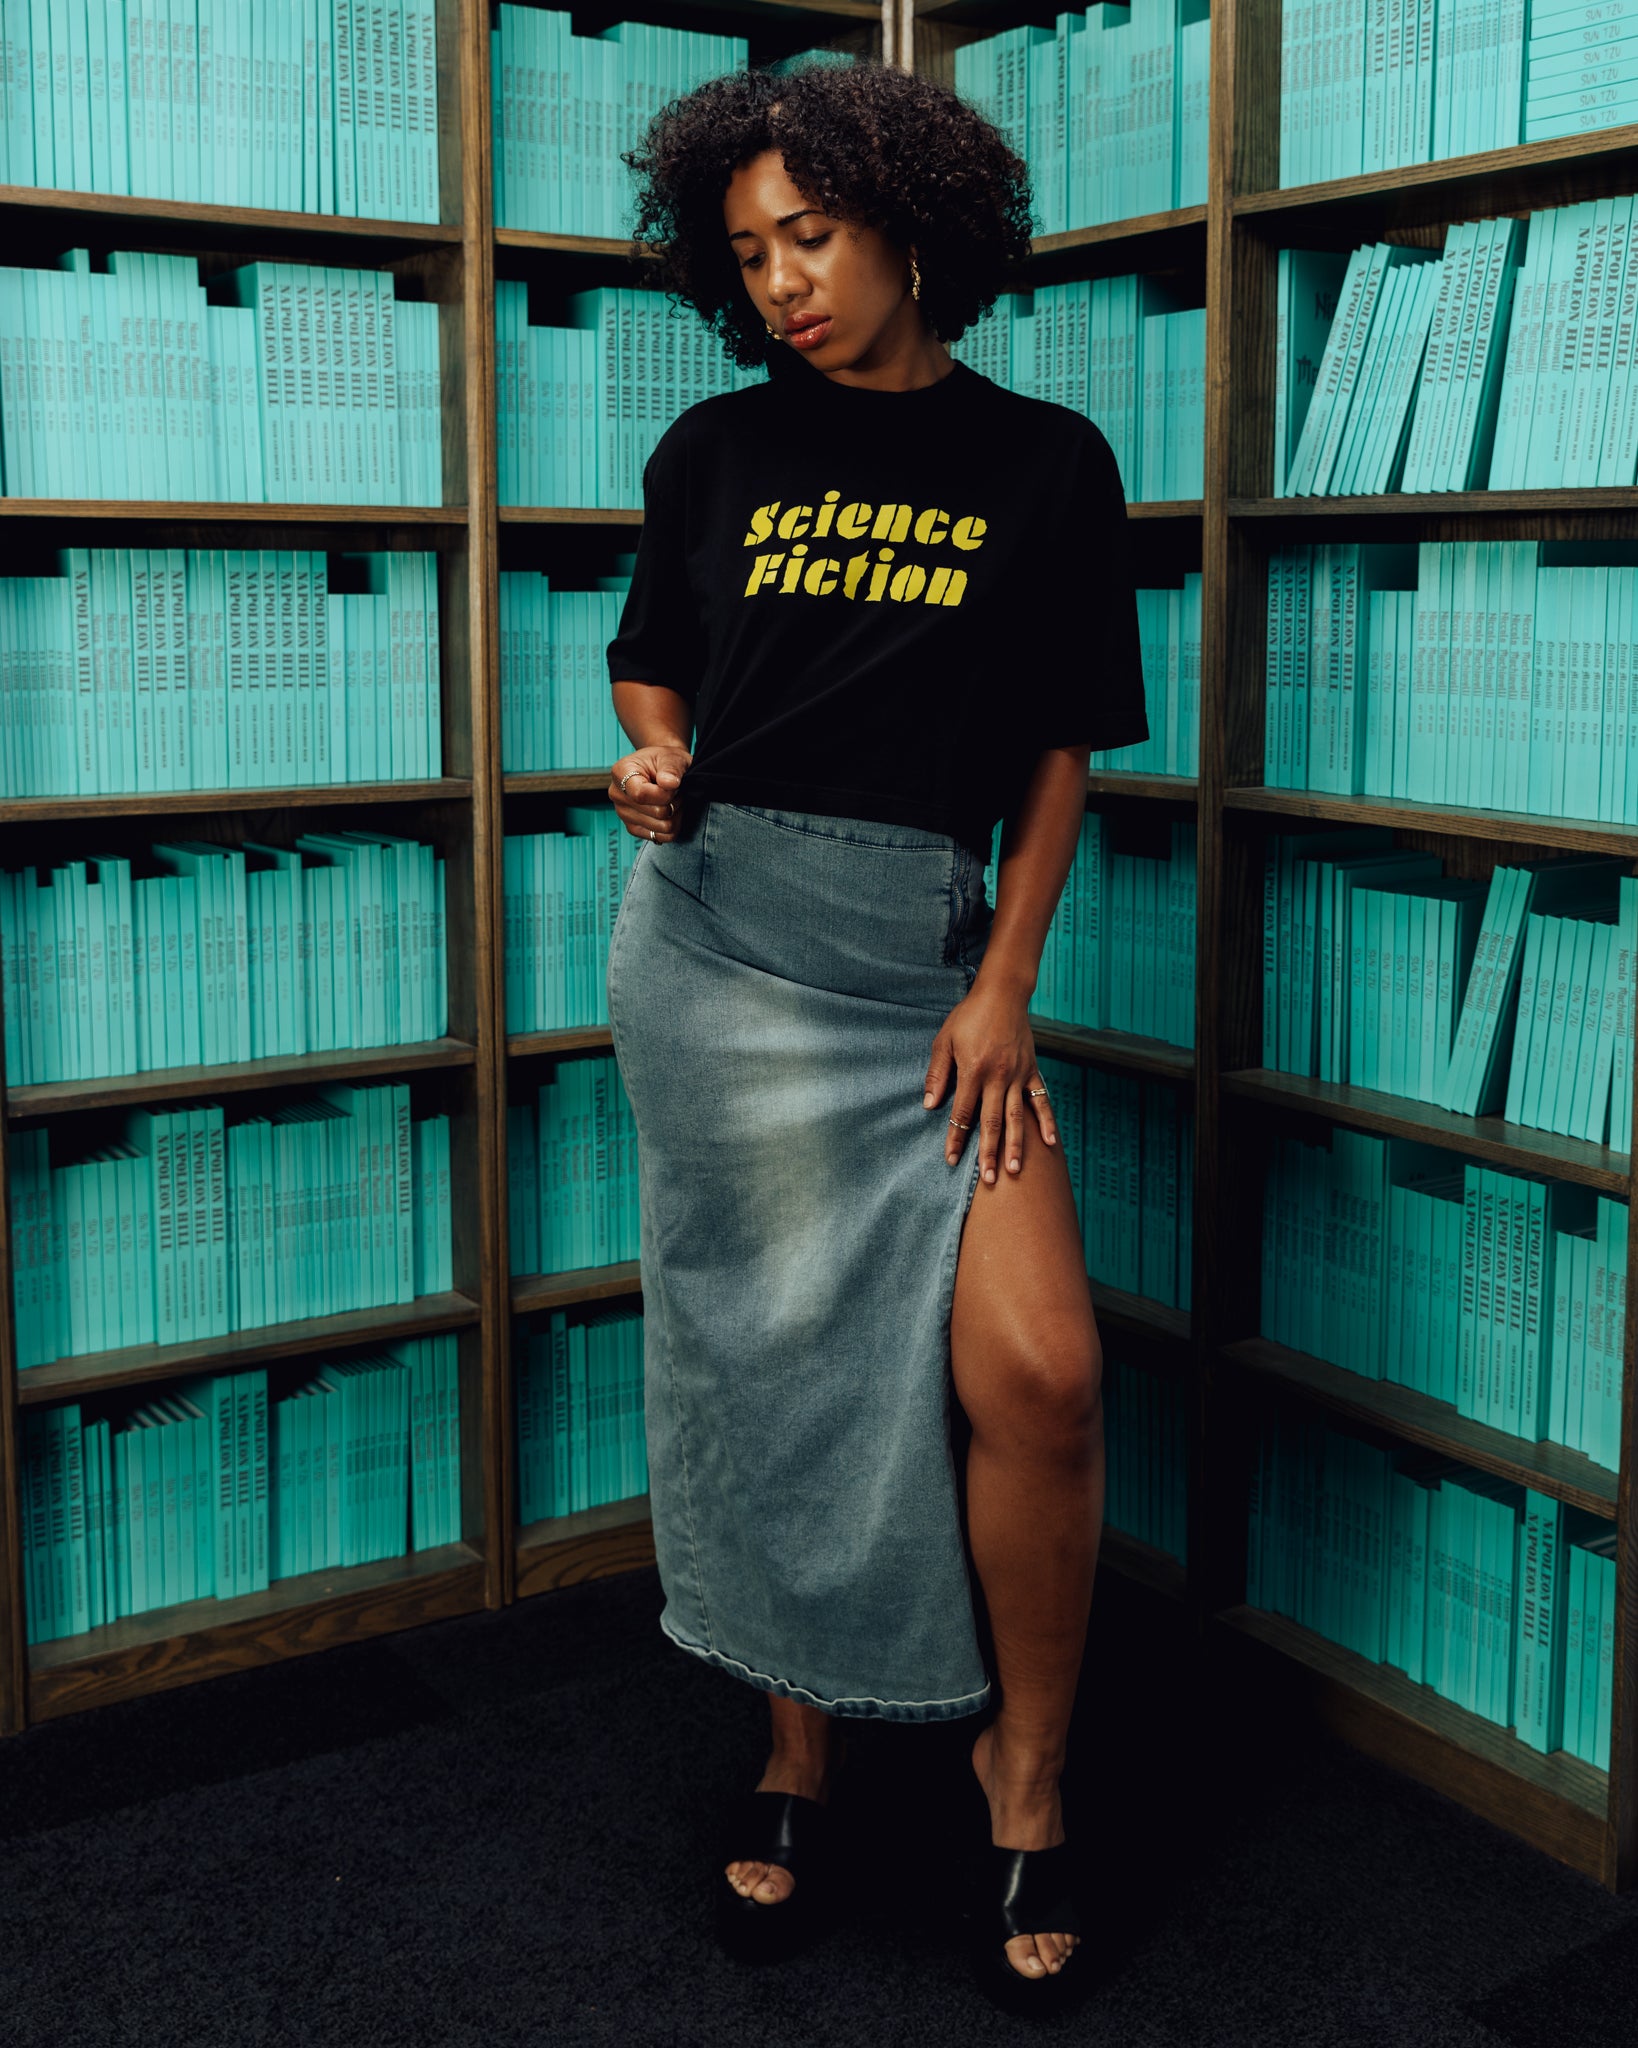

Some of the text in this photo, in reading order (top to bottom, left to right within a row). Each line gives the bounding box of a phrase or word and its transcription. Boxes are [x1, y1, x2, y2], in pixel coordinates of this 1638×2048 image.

[338, 3, 351, 126] NAPOLEON HILL
[356, 5, 370, 128] NAPOLEON HILL
[373, 8, 387, 130] NAPOLEON HILL
[390, 11, 402, 132] NAPOLEON HILL
[406, 13, 420, 134] NAPOLEON HILL
[424, 15, 435, 136] NAPOLEON HILL
[1374, 32, 1384, 78] HILL
[1390, 28, 1399, 73] HILL
[1405, 23, 1415, 70] HILL
[1420, 19, 1431, 67] HILL
[263, 285, 279, 408] NAPOLEON HILL
[281, 286, 297, 408] NAPOLEON HILL
[298, 287, 314, 408] NAPOLEON HILL
[315, 288, 330, 409] NAPOLEON HILL
[332, 290, 346, 410] NAPOLEON HILL
[348, 291, 363, 411] NAPOLEON HILL
[365, 291, 379, 411] NAPOLEON HILL
[382, 293, 396, 412] NAPOLEON HILL
[1326, 267, 1366, 395] NAPOLEON HILL
[1341, 266, 1382, 395] NAPOLEON HILL
[1423, 250, 1456, 387] NAPOLEON HILL
[1438, 248, 1471, 386] NAPOLEON HILL
[1454, 245, 1488, 383] NAPOLEON HILL
[1470, 242, 1504, 382] NAPOLEON HILL
[1561, 227, 1590, 374] NAPOLEON HILL
[1579, 224, 1608, 373] NAPOLEON HILL
[1596, 223, 1625, 372] NAPOLEON HILL
[1615, 322, 1631, 370] HILL
[606, 308, 617, 421] NAPOLEON HILL
[621, 309, 632, 422] NAPOLEON HILL
[636, 310, 647, 422] NAPOLEON HILL
[651, 312, 661, 423] NAPOLEON HILL
[743, 490, 987, 550] Science
[743, 544, 968, 606] Fiction
[76, 571, 92, 696] NAPOLEON HILL
[136, 571, 151, 695] NAPOLEON HILL
[154, 571, 169, 695] NAPOLEON HILL
[172, 570, 188, 694] NAPOLEON HILL
[229, 572, 244, 692] NAPOLEON HILL
[247, 572, 262, 692] NAPOLEON HILL
[264, 572, 278, 692] NAPOLEON HILL
[281, 572, 296, 692] NAPOLEON HILL
[297, 572, 312, 692] NAPOLEON HILL
[314, 572, 328, 691] NAPOLEON HILL
[1268, 566, 1279, 690] NAPOLEON HILL
[1282, 565, 1293, 690] NAPOLEON HILL
[1296, 566, 1308, 692] NAPOLEON HILL
[1329, 566, 1341, 693] NAPOLEON HILL
[1343, 566, 1355, 694] NAPOLEON HILL
[157, 1134, 172, 1252] NAPOLEON HILL
[175, 1132, 190, 1249] NAPOLEON HILL
[193, 1130, 208, 1248] NAPOLEON HILL
[210, 1128, 224, 1245] NAPOLEON HILL
[397, 1105, 411, 1217] NAPOLEON HILL
[1463, 1187, 1476, 1316] NAPOLEON HILL
[1479, 1191, 1493, 1320] NAPOLEON HILL
[1494, 1196, 1509, 1326] NAPOLEON HILL
[1510, 1200, 1524, 1331] NAPOLEON HILL
[1526, 1204, 1541, 1336] NAPOLEON HILL
[1523, 1599, 1535, 1640] HILL
[1538, 1606, 1550, 1648] HILL
